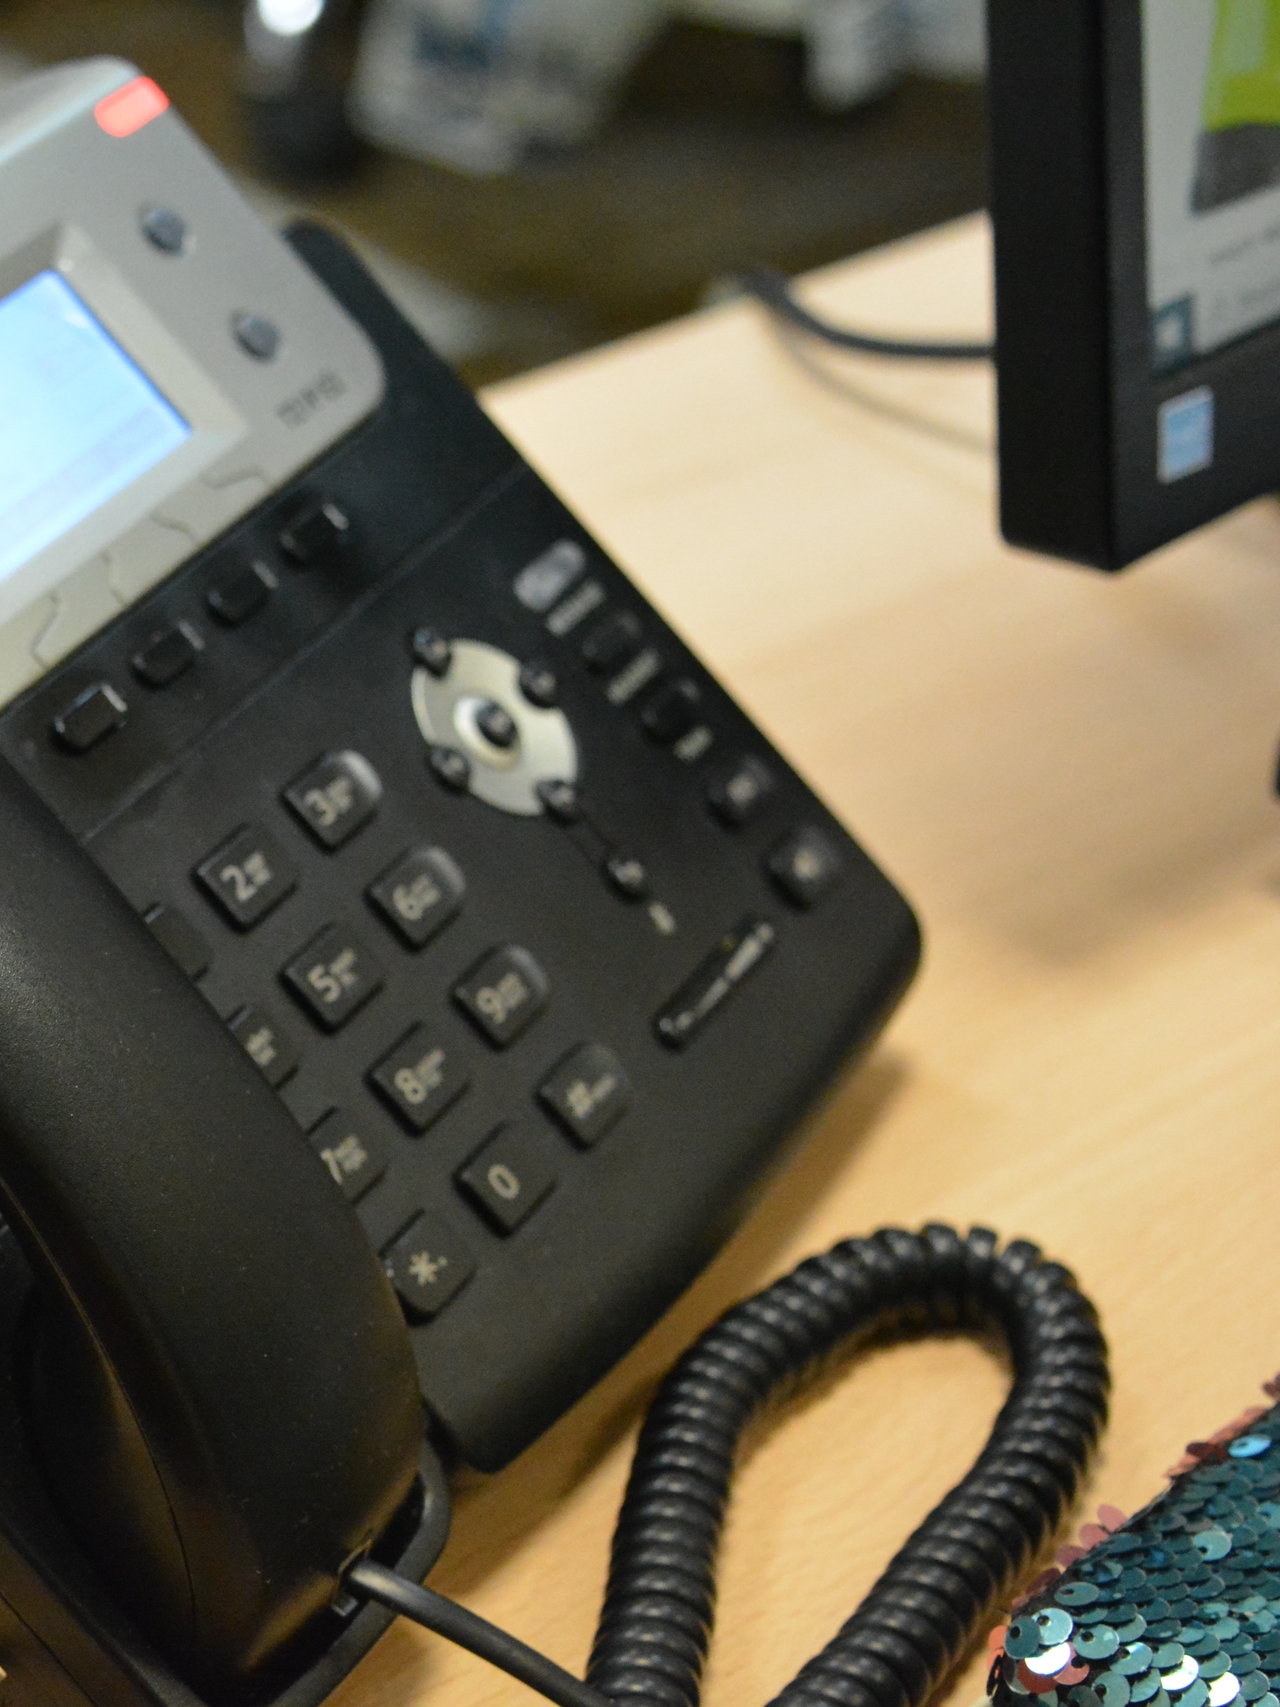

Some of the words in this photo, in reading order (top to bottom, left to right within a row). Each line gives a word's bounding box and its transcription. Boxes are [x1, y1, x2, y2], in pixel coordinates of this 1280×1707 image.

[304, 788, 338, 826] 3
[221, 864, 257, 901] 2
[392, 884, 424, 921] 6
[307, 964, 341, 1003] 5
[476, 986, 506, 1024] 9
[394, 1068, 427, 1104] 8
[487, 1164, 519, 1200] 0
